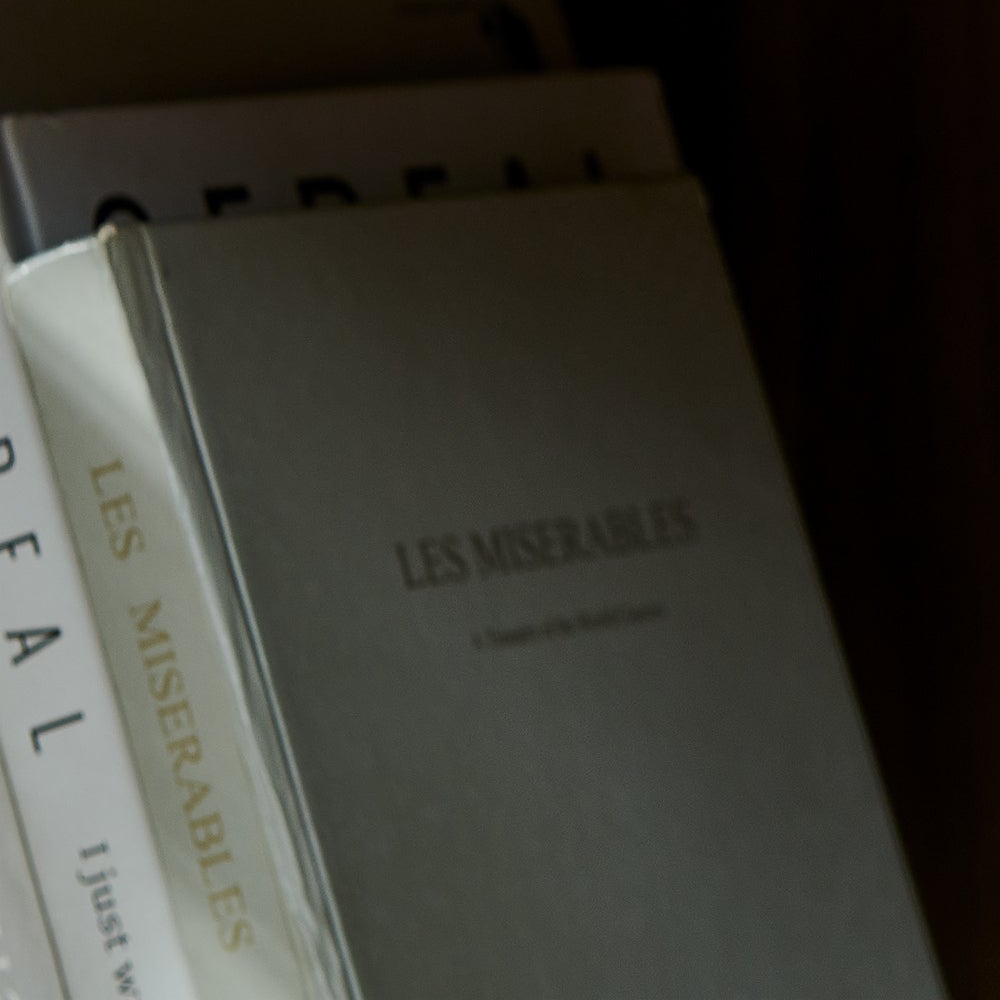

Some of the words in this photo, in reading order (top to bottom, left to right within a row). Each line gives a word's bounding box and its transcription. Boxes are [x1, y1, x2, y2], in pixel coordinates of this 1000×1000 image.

[394, 539, 470, 591] LES
[89, 456, 145, 562] LES
[129, 597, 256, 954] MISERABLES
[75, 866, 130, 954] just
